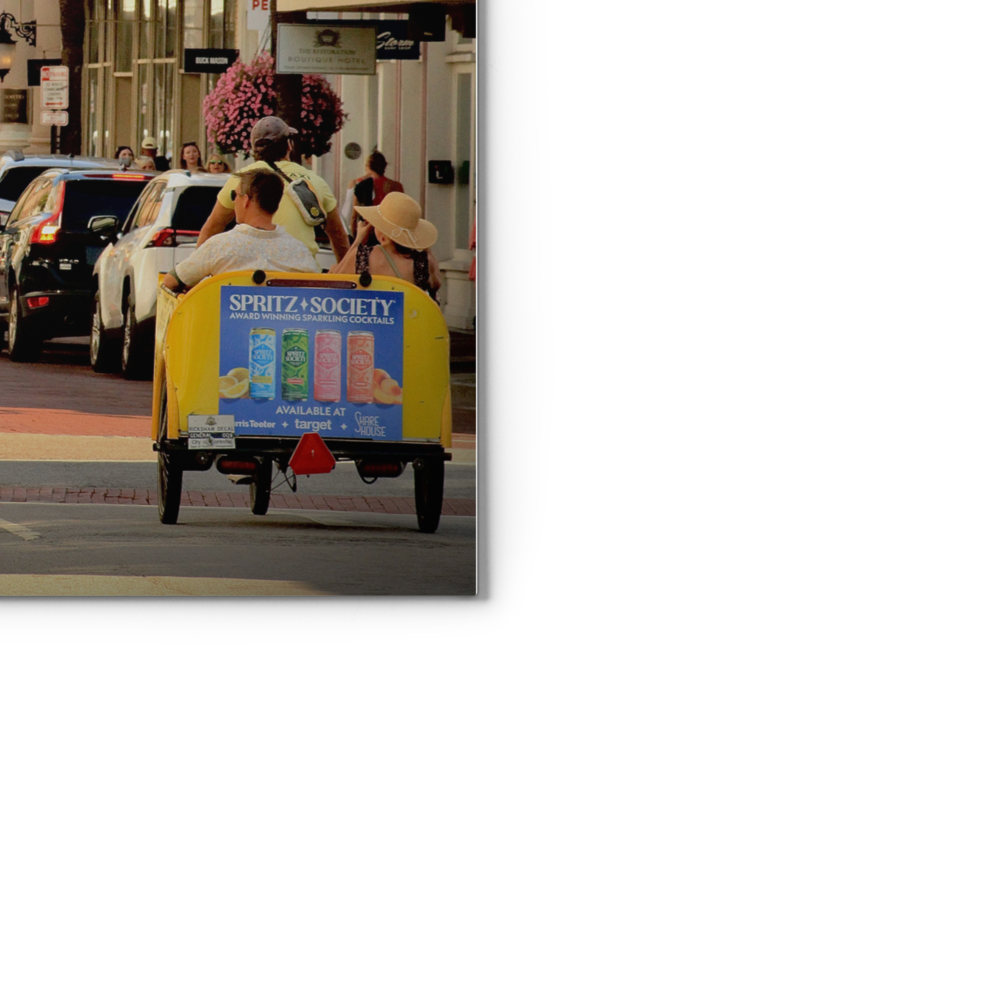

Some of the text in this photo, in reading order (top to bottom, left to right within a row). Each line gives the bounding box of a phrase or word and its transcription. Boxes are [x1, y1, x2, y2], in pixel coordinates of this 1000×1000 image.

[252, 0, 268, 10] PE
[229, 294, 393, 316] SPRITZ SOCIETY
[229, 312, 394, 325] AWARD WINNING SPARKLING COCKTAILS
[276, 406, 346, 416] AVAILABLE AT
[234, 420, 249, 428] rris
[294, 418, 332, 432] target
[360, 426, 386, 437] HOUSE
